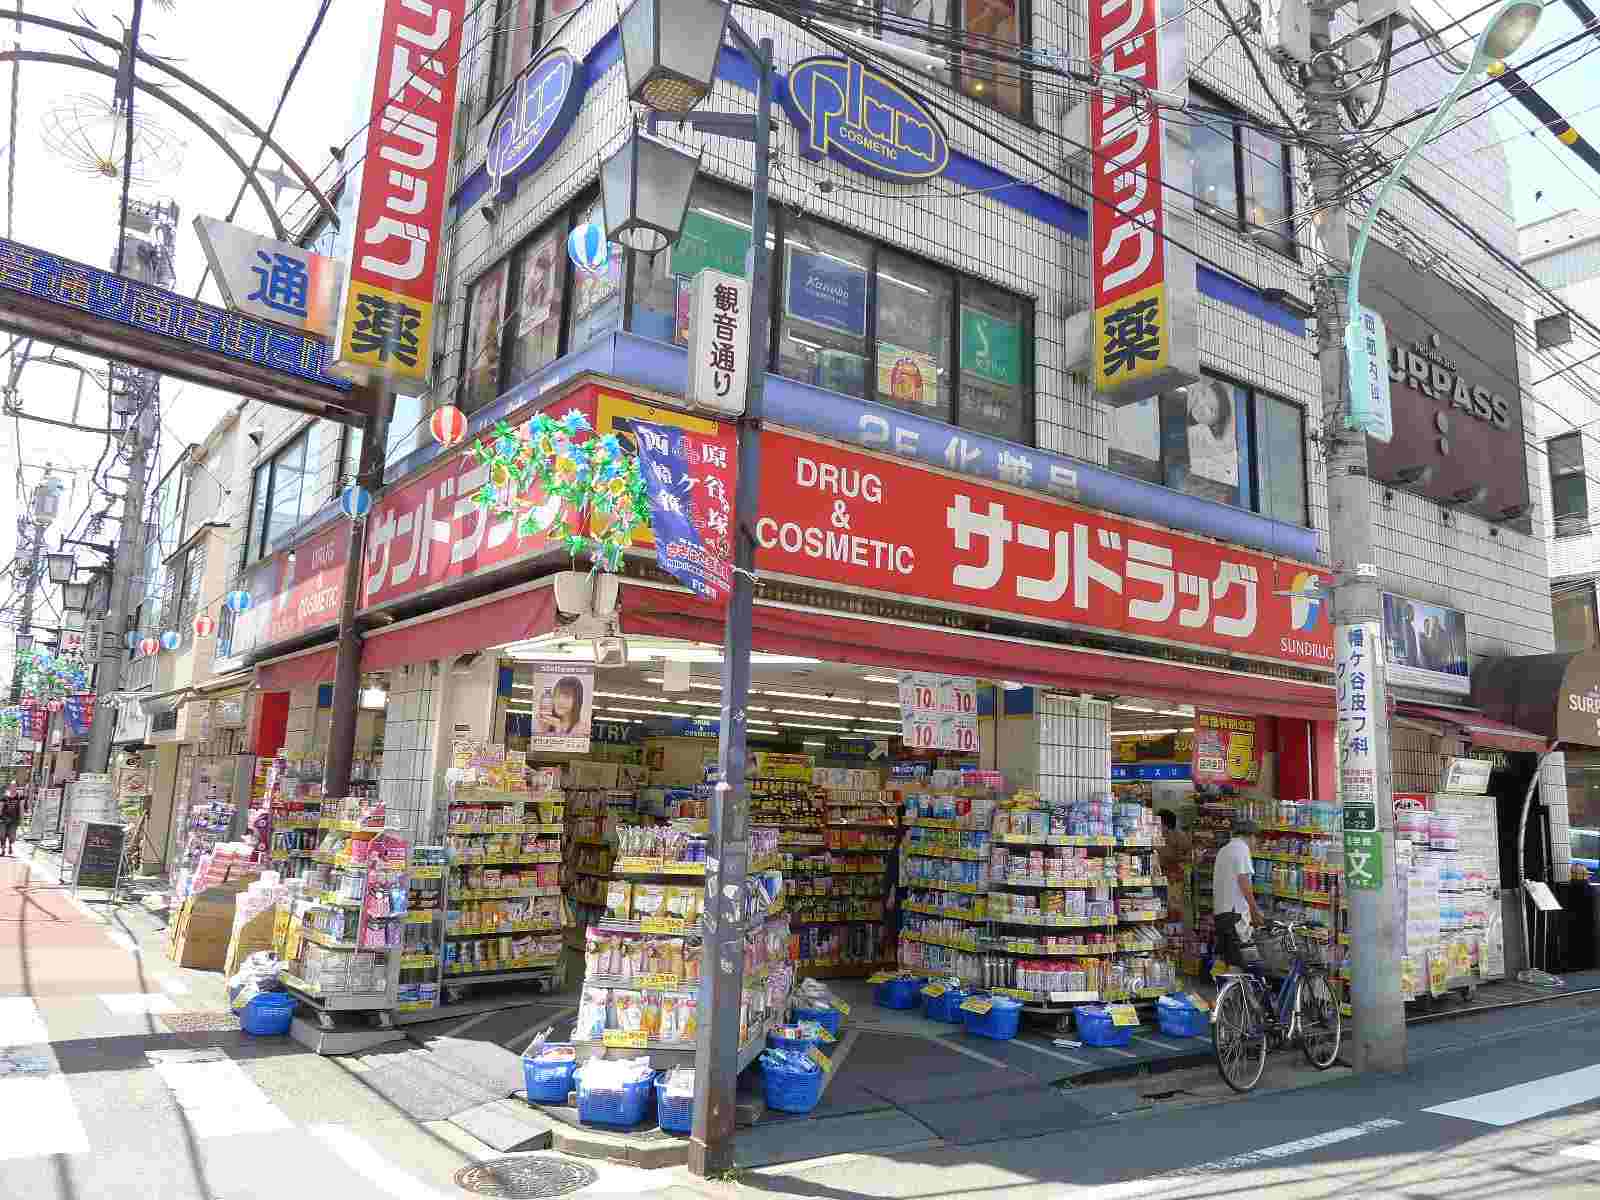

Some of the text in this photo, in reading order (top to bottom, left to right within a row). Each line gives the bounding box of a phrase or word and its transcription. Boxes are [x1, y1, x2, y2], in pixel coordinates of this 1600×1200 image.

[839, 124, 898, 160] COSMETIC
[351, 293, 421, 367] 薬
[710, 282, 739, 397] 観音通り
[1103, 297, 1160, 376] 薬
[1390, 347, 1510, 430] URPASS
[794, 456, 882, 504] DRUG
[830, 499, 851, 529] &
[754, 516, 915, 575] COSMETIC
[945, 493, 1258, 638] サンドラッグ
[1280, 637, 1335, 661] SUNDRUG
[1347, 848, 1373, 880] 文
